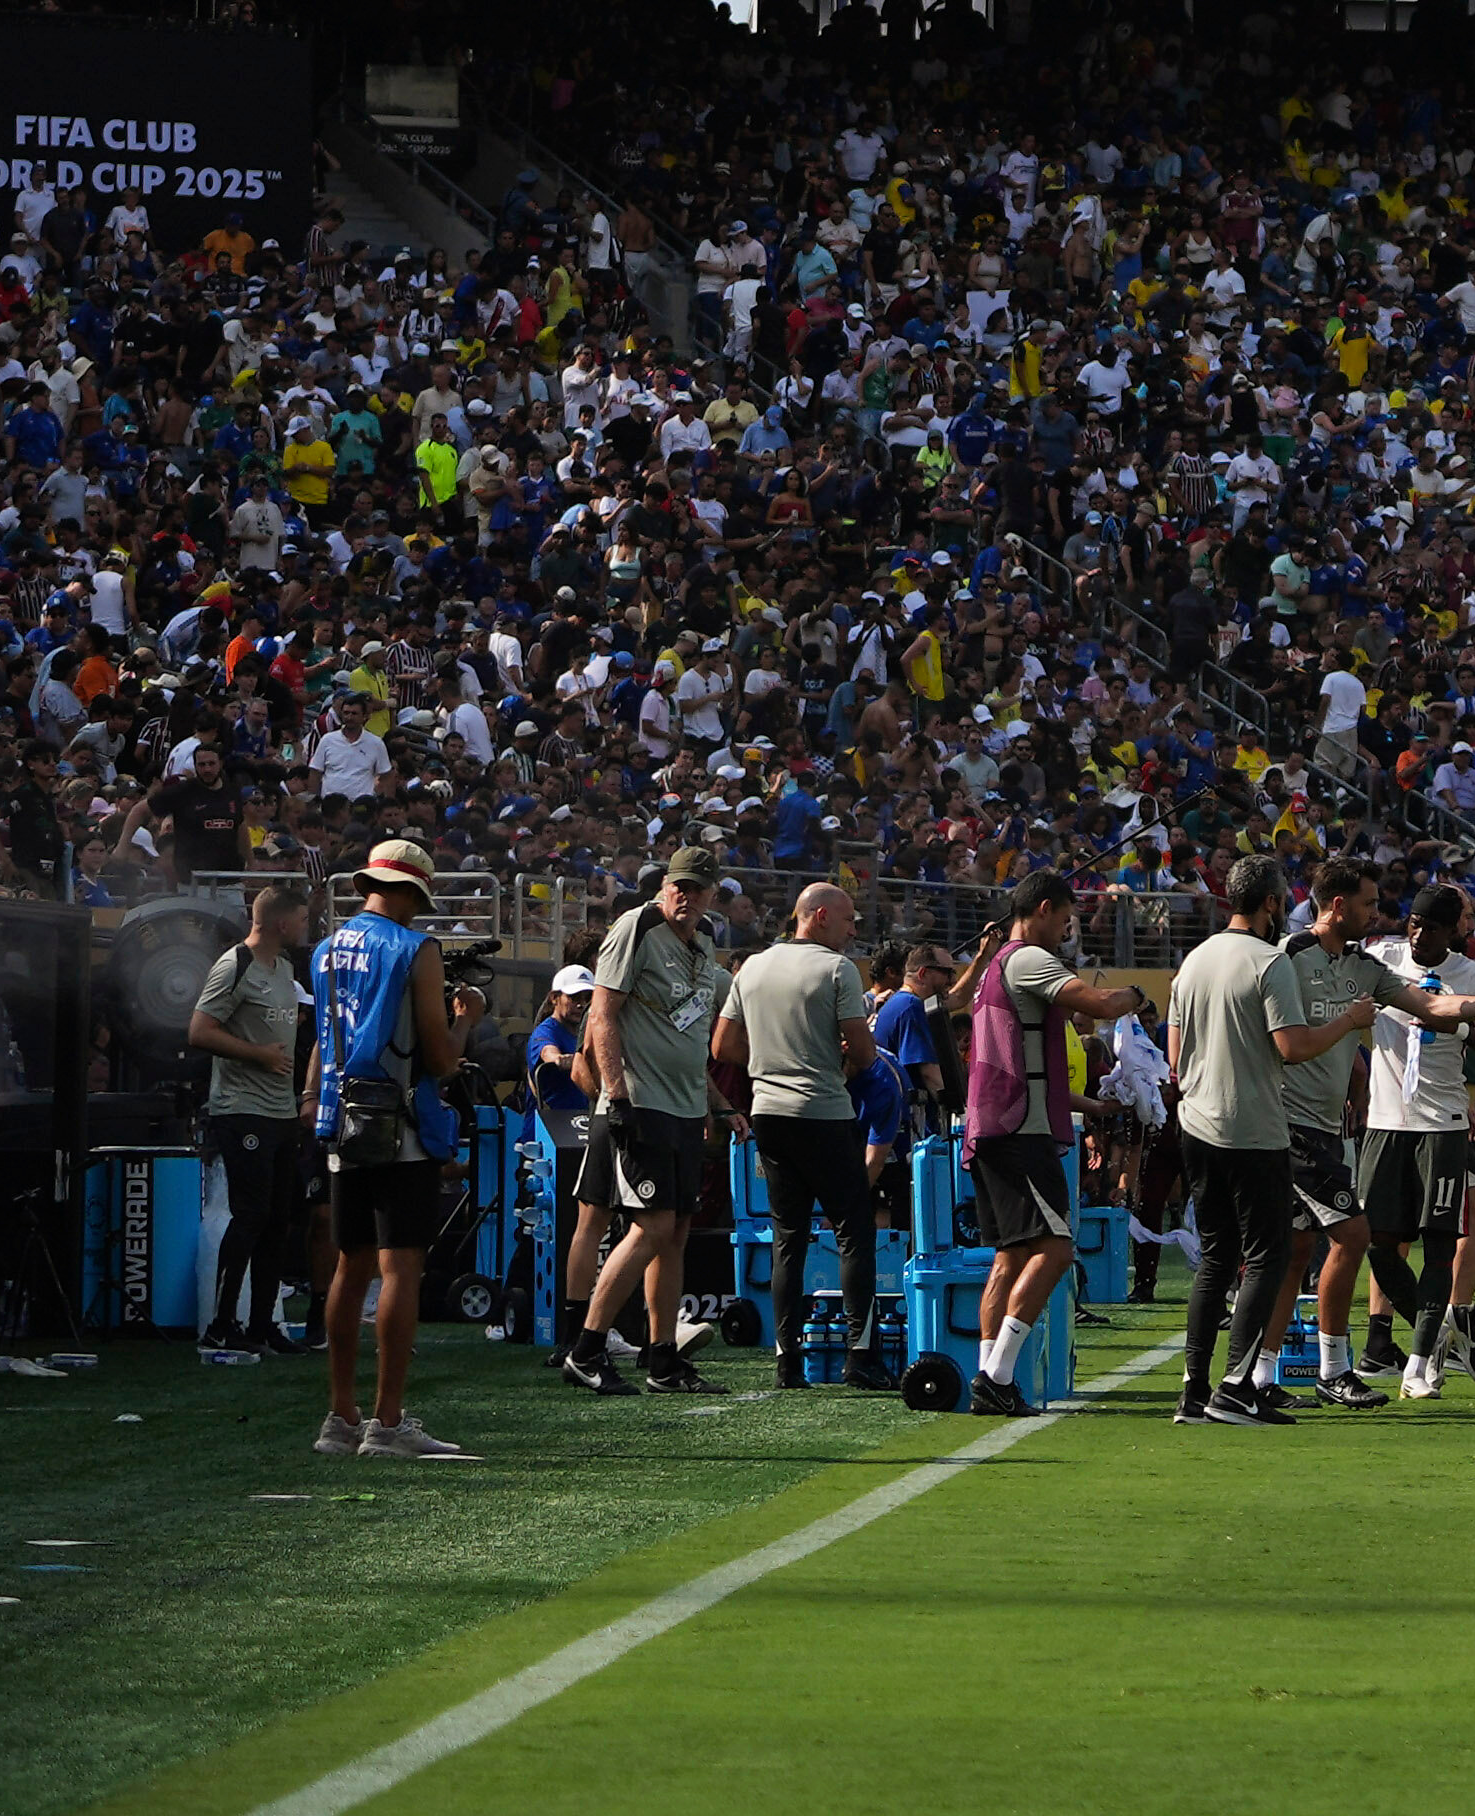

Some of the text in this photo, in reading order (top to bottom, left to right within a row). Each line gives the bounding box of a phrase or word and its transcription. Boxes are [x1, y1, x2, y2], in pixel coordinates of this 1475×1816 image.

[15, 114, 197, 154] FIFA CLUB
[90, 163, 167, 194] CUP
[1434, 1176, 1456, 1208] 11
[124, 1160, 149, 1323] POWERADE
